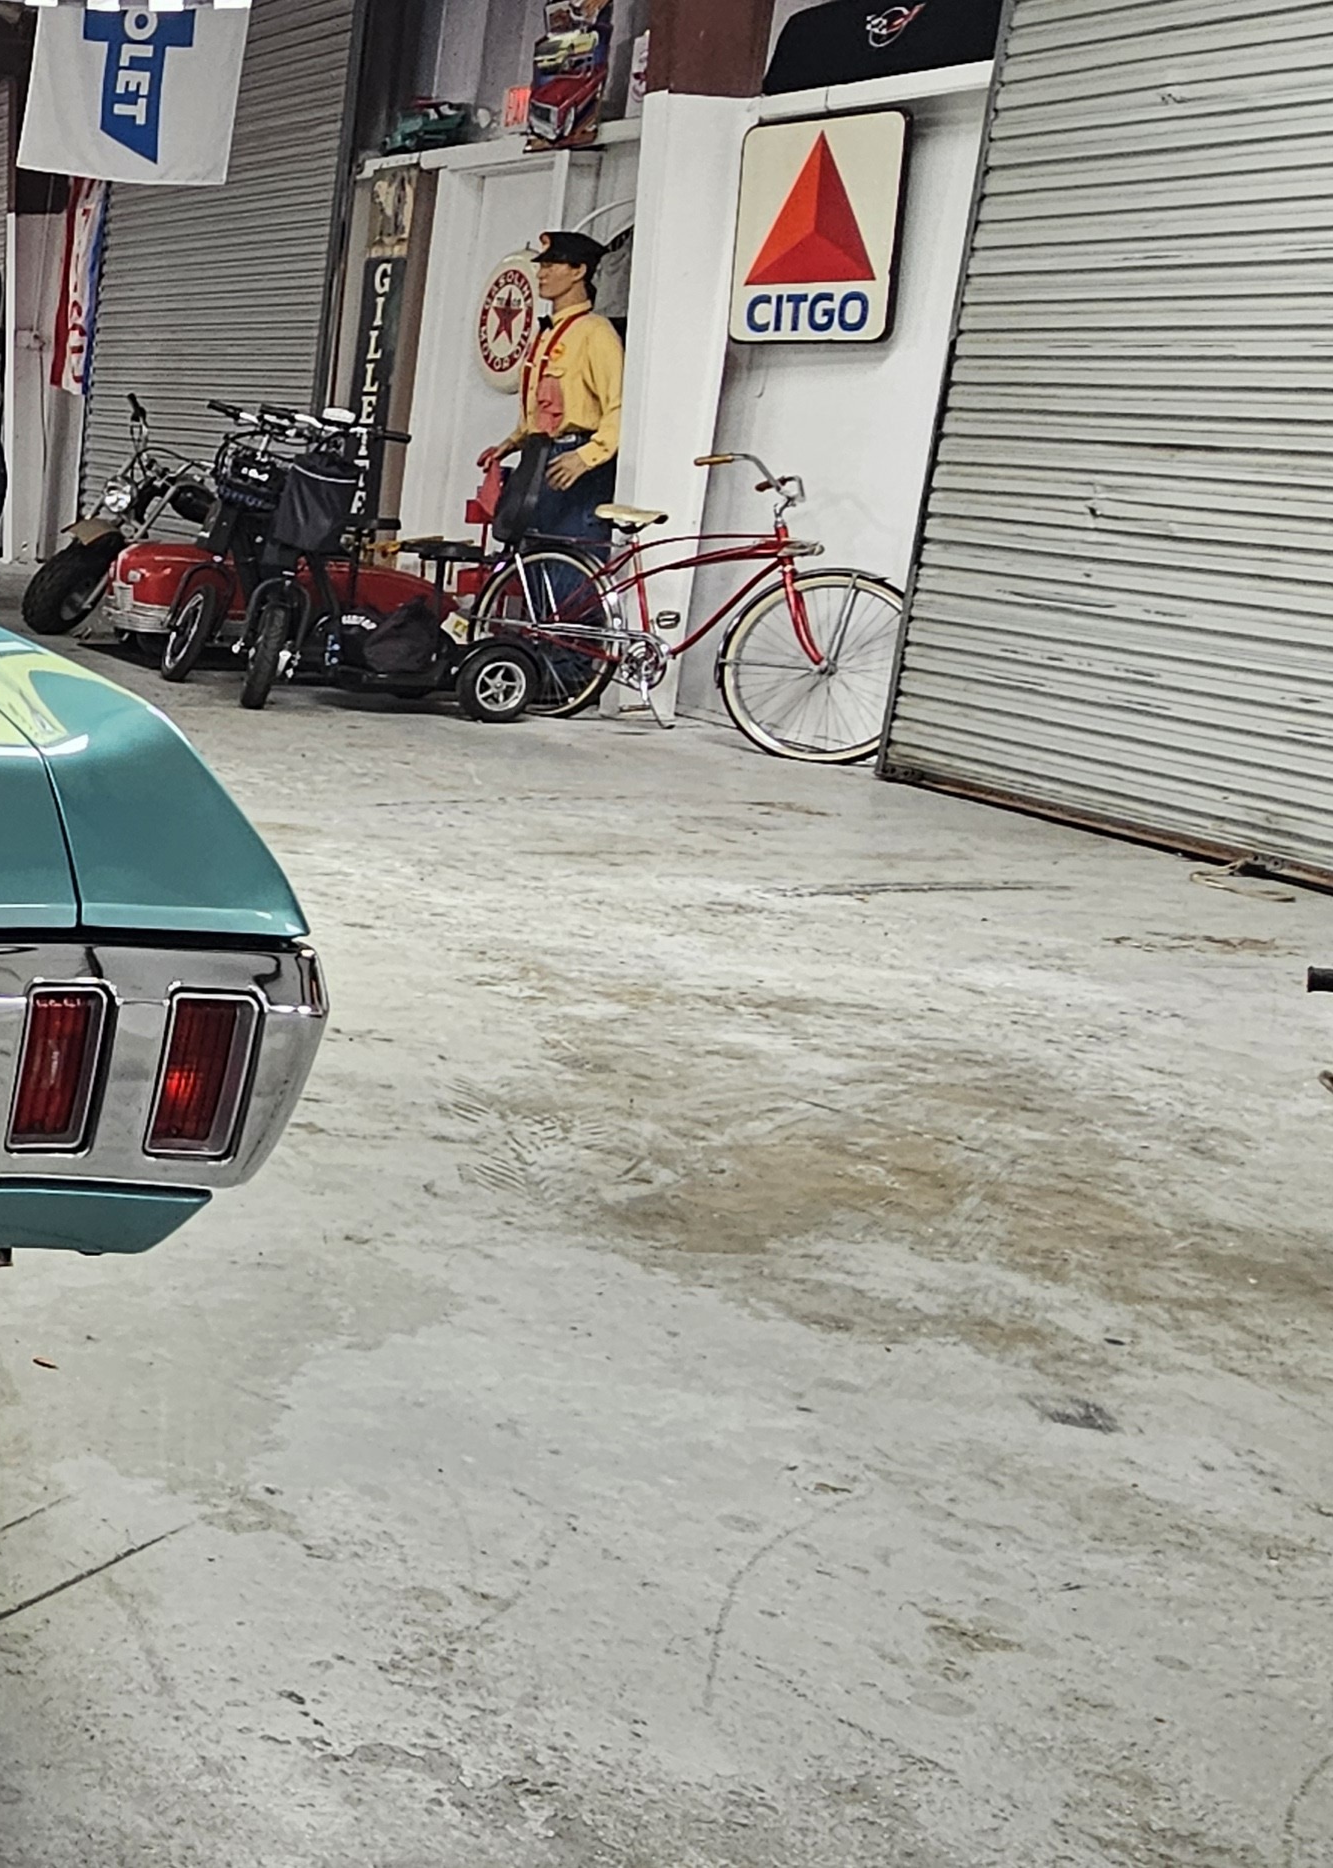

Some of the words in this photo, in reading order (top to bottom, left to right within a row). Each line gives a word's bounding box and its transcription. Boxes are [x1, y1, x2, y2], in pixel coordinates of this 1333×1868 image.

[113, 10, 158, 125] OLET
[746, 291, 870, 333] CITGO
[350, 263, 392, 516] GILLETTE
